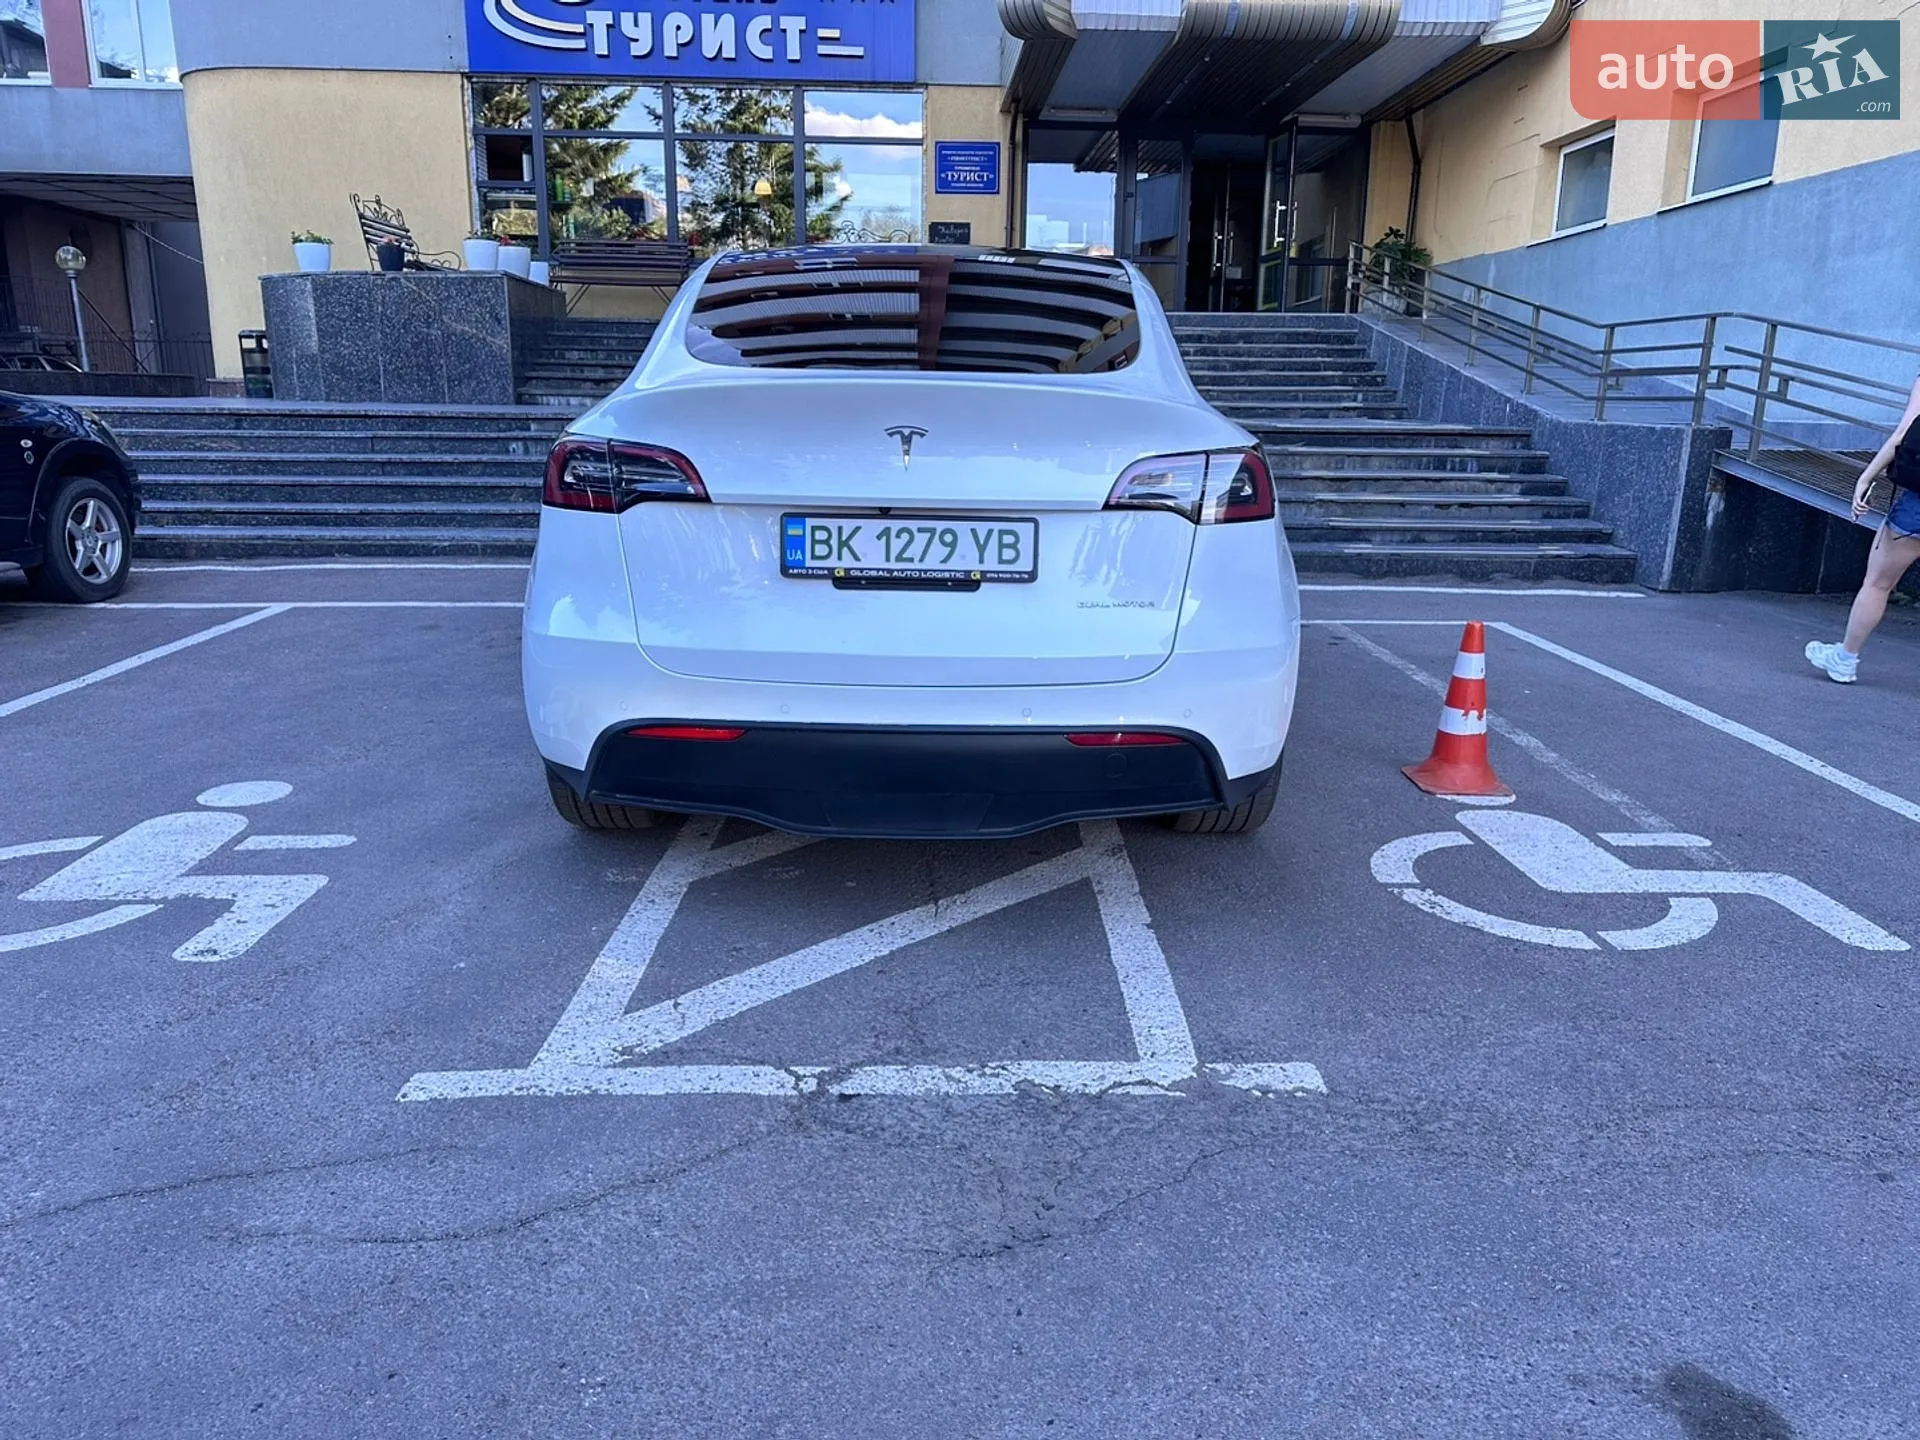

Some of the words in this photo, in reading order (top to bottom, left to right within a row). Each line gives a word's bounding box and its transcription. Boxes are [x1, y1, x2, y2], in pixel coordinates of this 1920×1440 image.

[585, 10, 807, 61] ТУРИСТ
[787, 549, 803, 561] UA
[810, 524, 863, 563] BK
[875, 526, 959, 564] 1279
[969, 528, 1021, 566] YB
[850, 569, 890, 577] GLOBAL
[892, 570, 920, 578] AUTO
[921, 570, 965, 579] LOGISTIC
